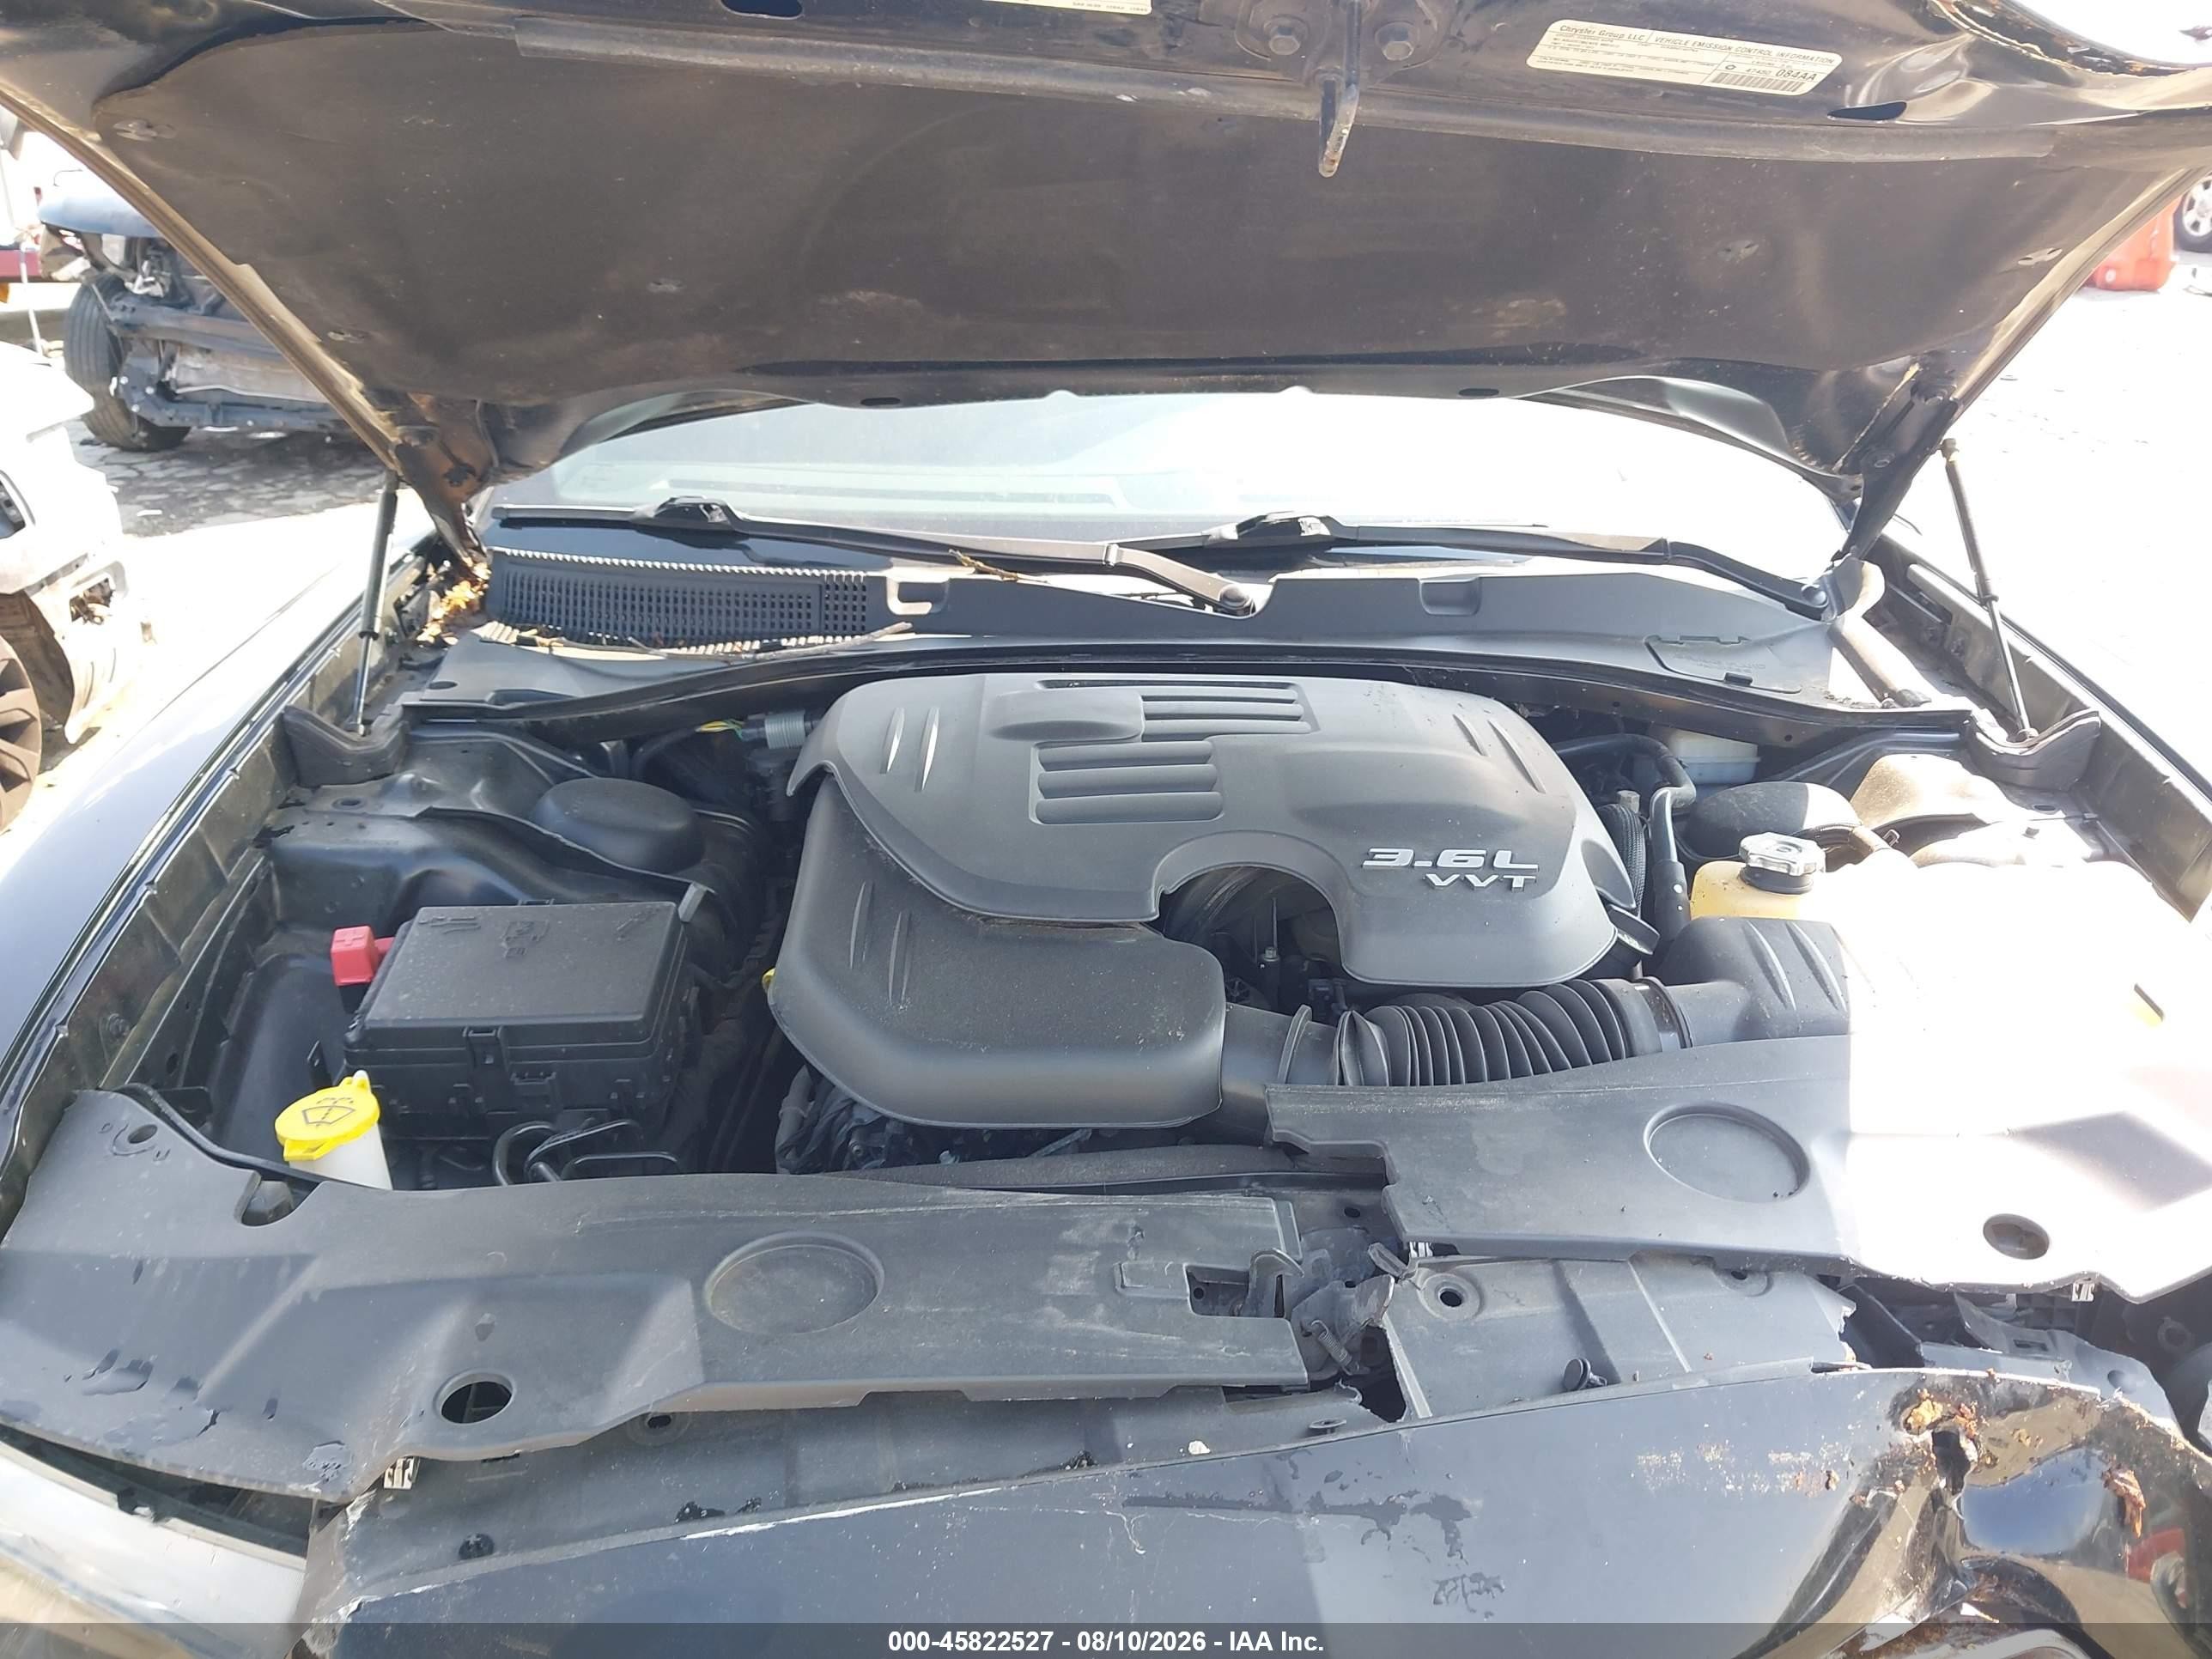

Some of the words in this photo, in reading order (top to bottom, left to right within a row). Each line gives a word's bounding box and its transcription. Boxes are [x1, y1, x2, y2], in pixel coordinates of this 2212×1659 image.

[1559, 25, 1595, 36] Chrysler
[1598, 29, 1626, 40] Group
[1654, 36, 1691, 46] VEHICLE
[1692, 40, 1733, 52] EMISSION
[1735, 46, 1772, 57] CONTROL
[1777, 52, 1835, 64] INFORMATION
[1775, 69, 1817, 82] 084AA
[1361, 847, 1539, 871] 3.6L
[1423, 873, 1536, 891] VVT
